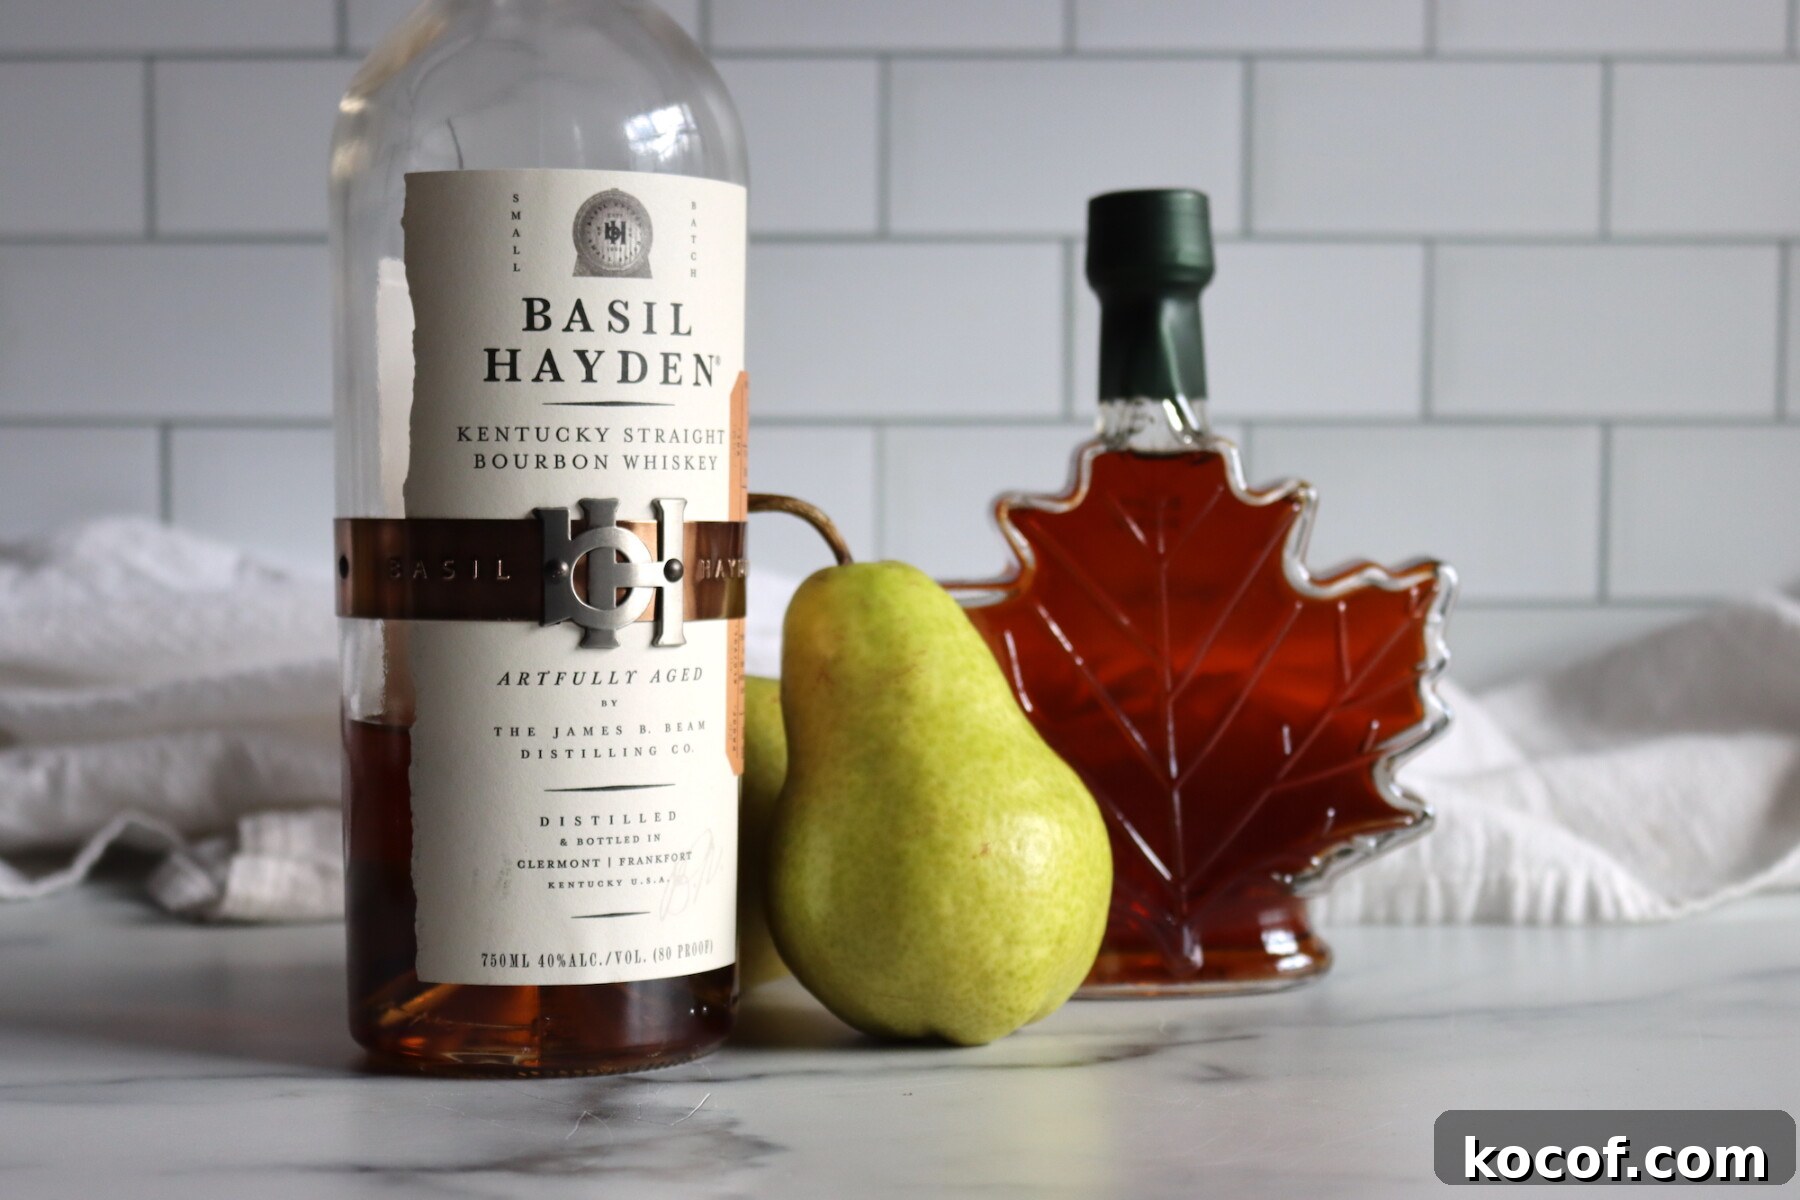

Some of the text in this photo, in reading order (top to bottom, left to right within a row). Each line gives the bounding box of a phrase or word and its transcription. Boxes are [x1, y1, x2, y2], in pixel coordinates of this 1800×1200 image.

[510, 193, 522, 273] SMALL
[689, 200, 698, 279] BATCH
[521, 296, 692, 337] BASIL
[457, 426, 610, 443] KENTUCKY
[623, 427, 725, 445] STRAIGHT
[473, 453, 718, 471] BOURBON WHISKEY
[388, 558, 512, 581] BASIL
[496, 666, 704, 687] ARTFULLY AGED
[600, 699, 618, 708] BY
[493, 720, 706, 740] THE JAMES B. BEAM
[520, 743, 695, 760] DISTILLING CO.
[539, 810, 677, 828] DISTILLED
[559, 833, 662, 847] & BOTTLED IN
[516, 858, 601, 870] CLERMONT
[618, 851, 693, 868] FRANKFORT
[547, 876, 671, 890] KENTUCKY U.S.A.
[481, 952, 530, 969] 750ML
[652, 945, 672, 964] (80
[677, 939, 714, 960] PROOF)
